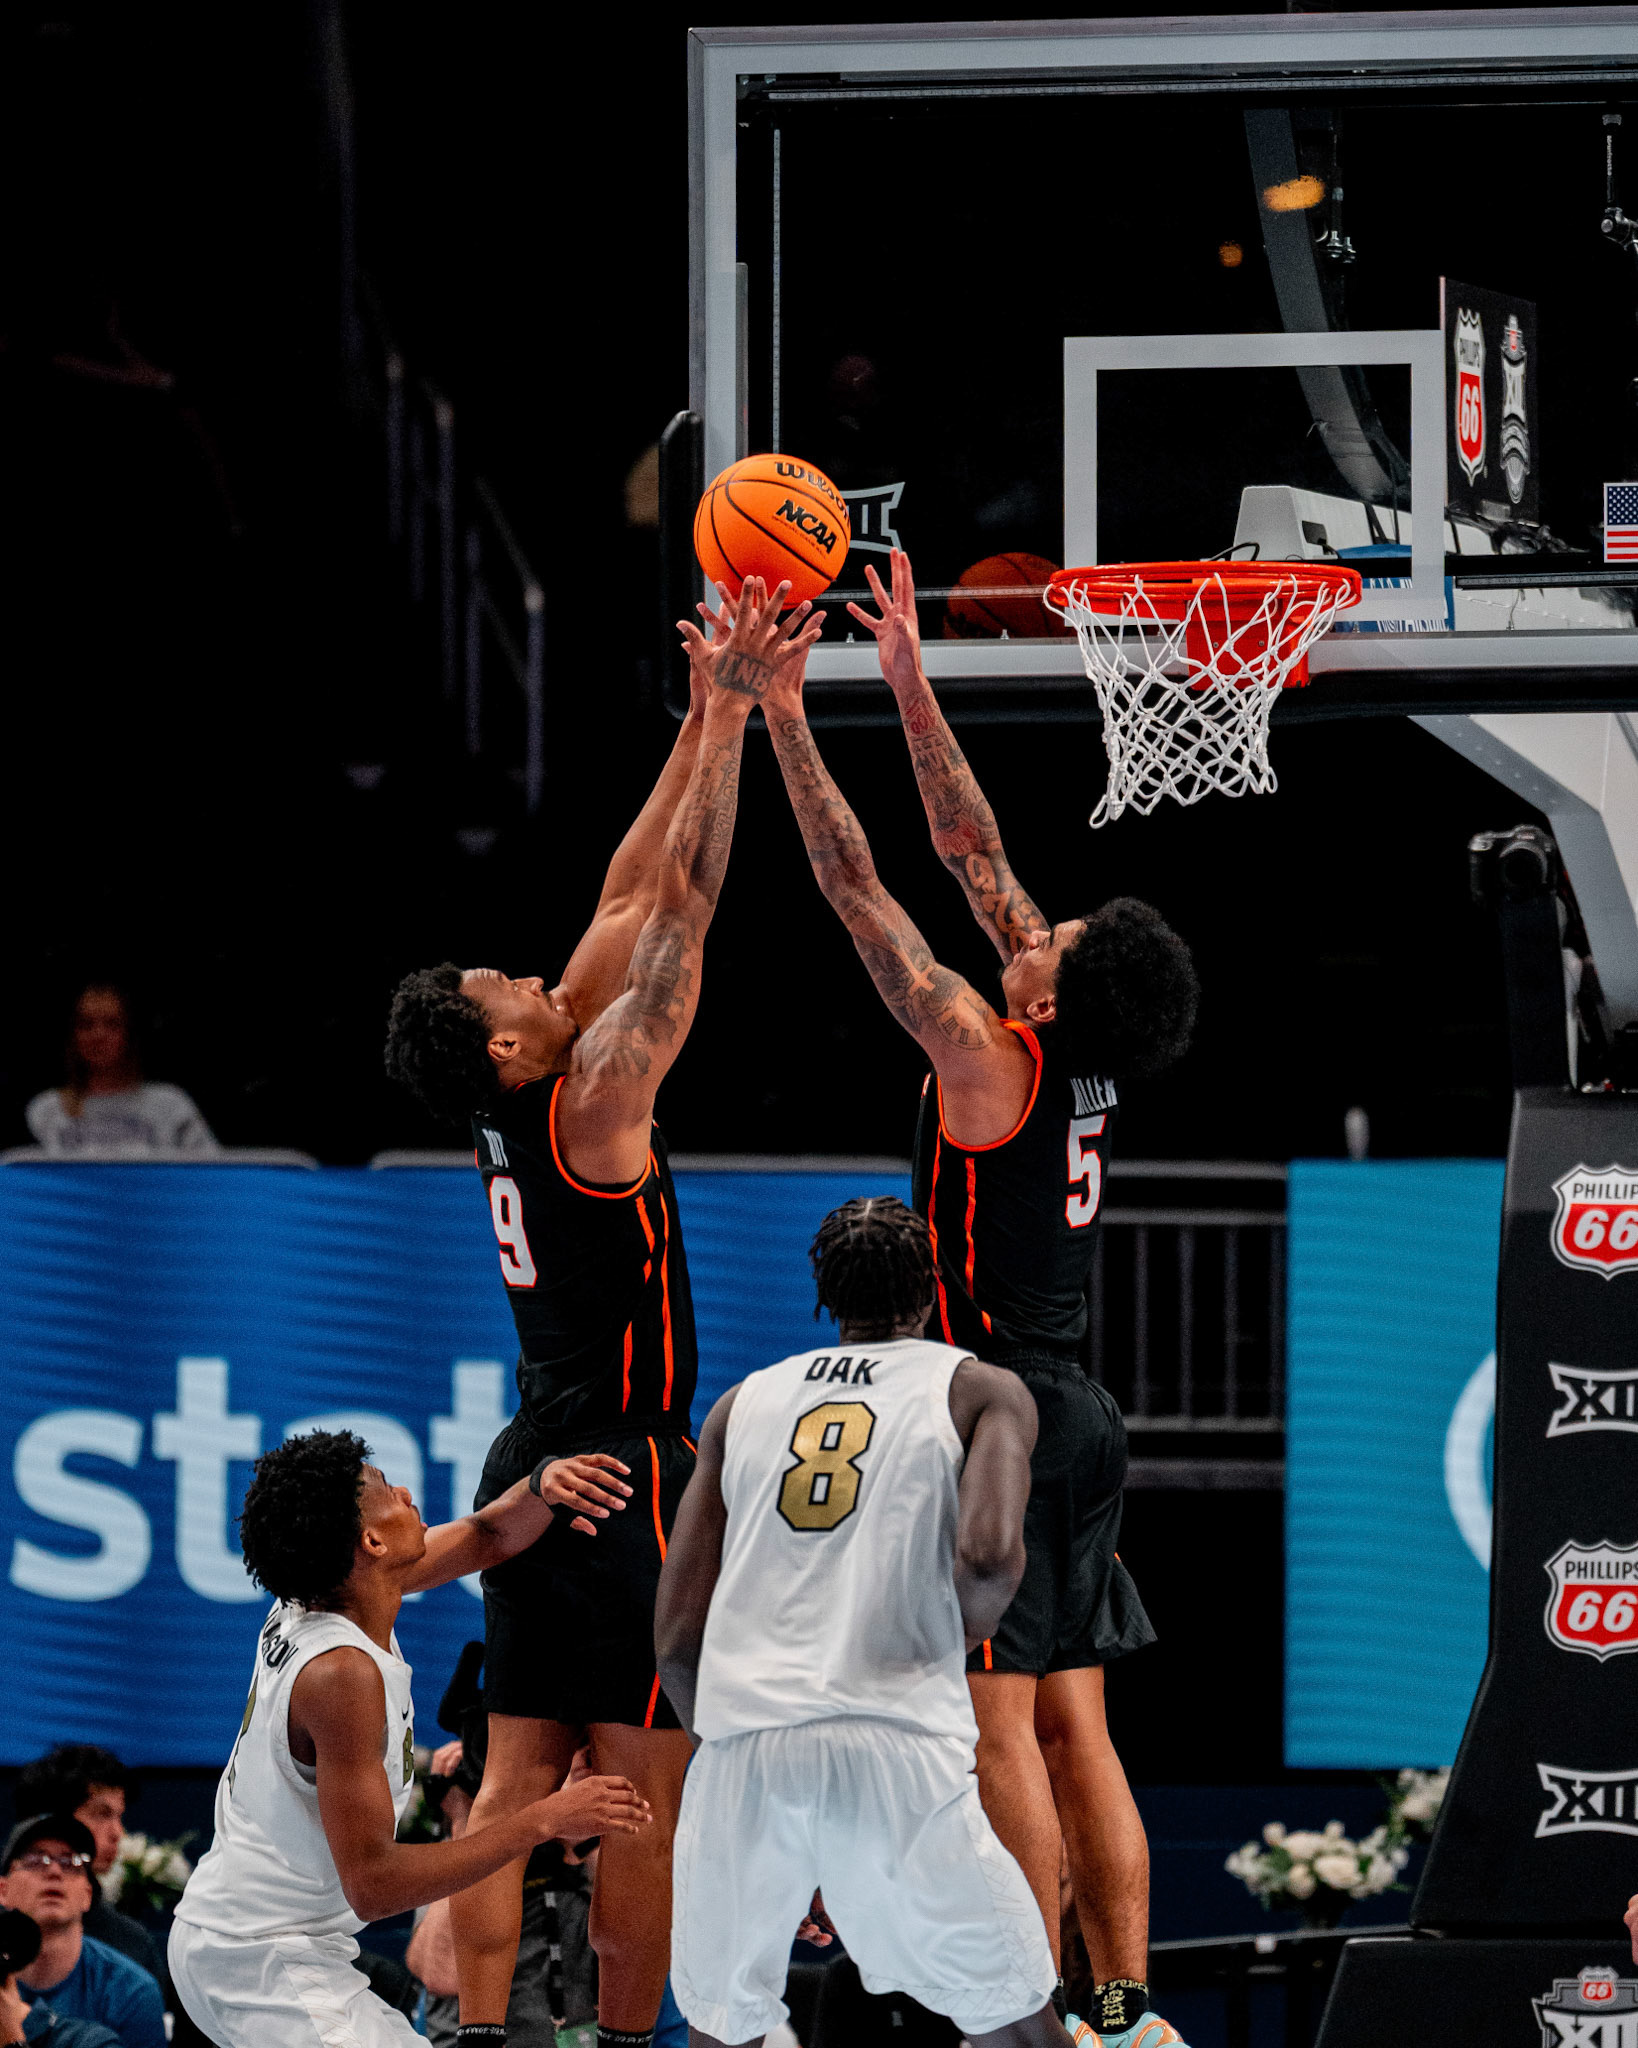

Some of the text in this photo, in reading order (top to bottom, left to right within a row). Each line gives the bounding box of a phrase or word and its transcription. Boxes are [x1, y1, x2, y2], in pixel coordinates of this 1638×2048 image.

[1461, 383, 1481, 442] 66
[776, 499, 837, 554] NCAA
[1065, 1114, 1107, 1229] 5
[490, 1175, 538, 1288] 9
[1573, 1210, 1638, 1251] 66
[776, 1401, 878, 1532] 8
[1567, 1590, 1637, 1632] 66
[1585, 1983, 1609, 1998] 66
